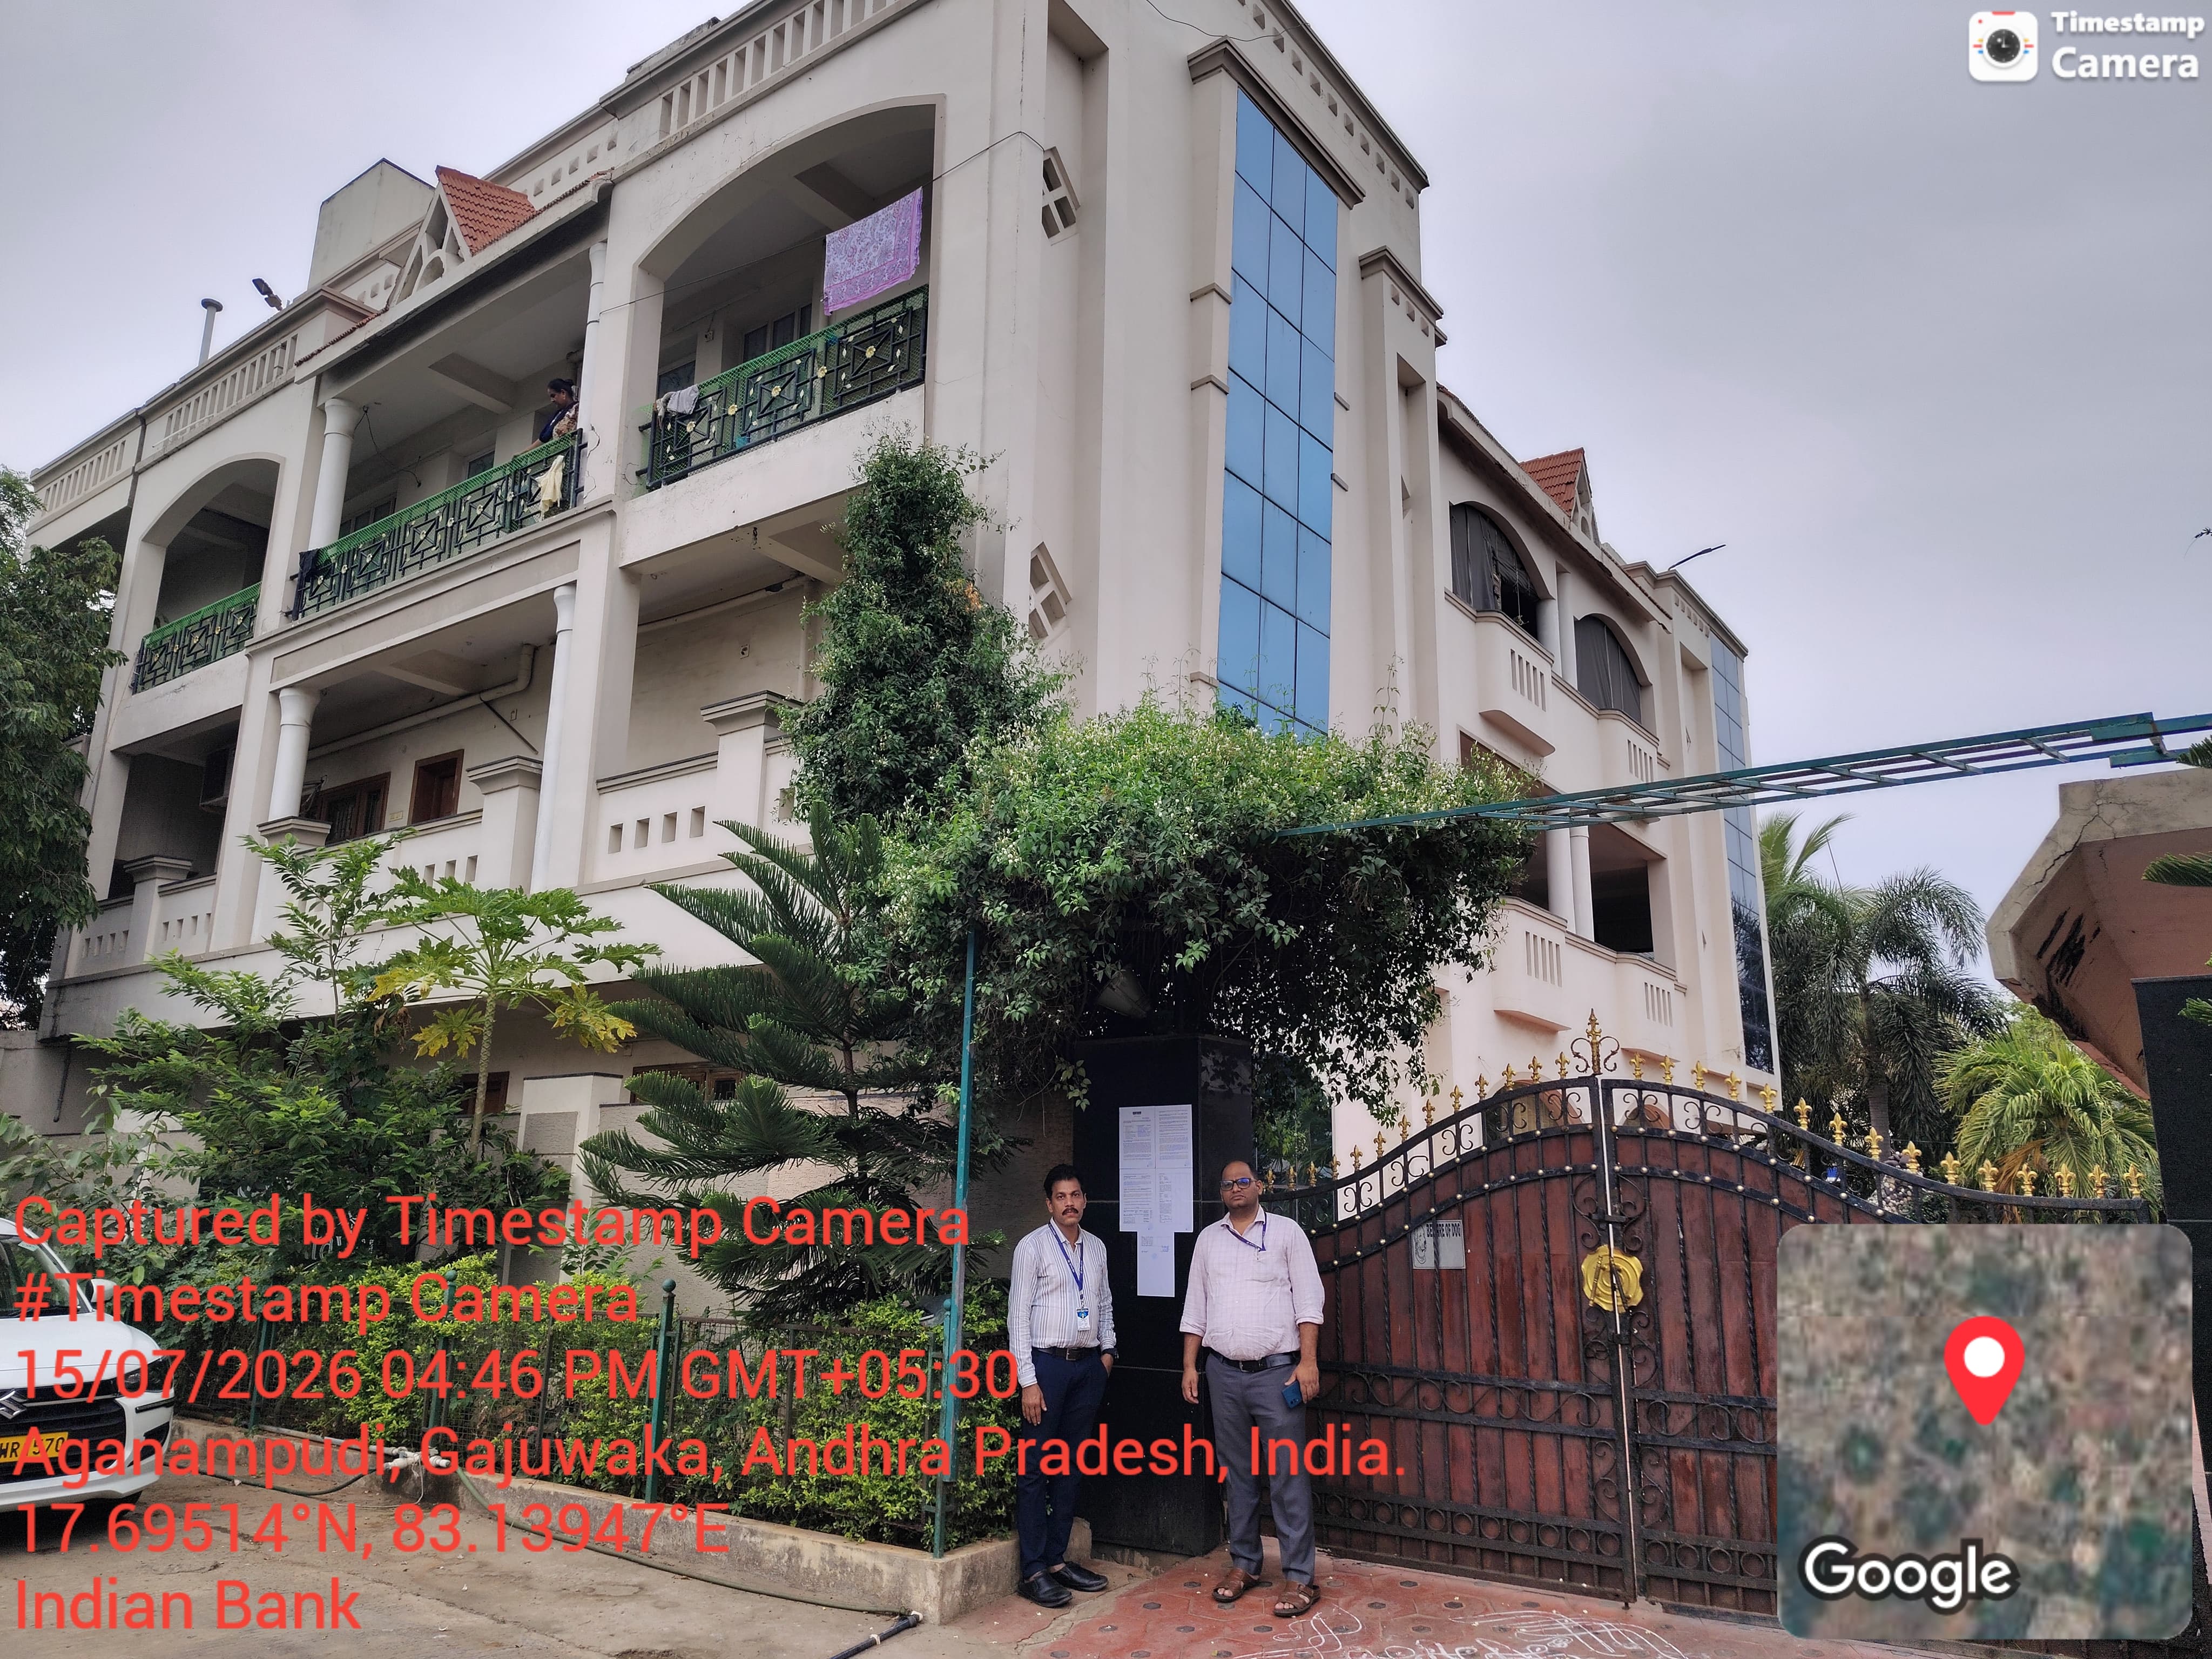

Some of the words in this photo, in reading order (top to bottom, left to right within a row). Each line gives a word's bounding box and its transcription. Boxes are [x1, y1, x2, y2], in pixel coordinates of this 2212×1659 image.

[1426, 1223, 1445, 1238] BEARE
[1445, 1223, 1451, 1238] OF
[1451, 1223, 1461, 1237] DOG
